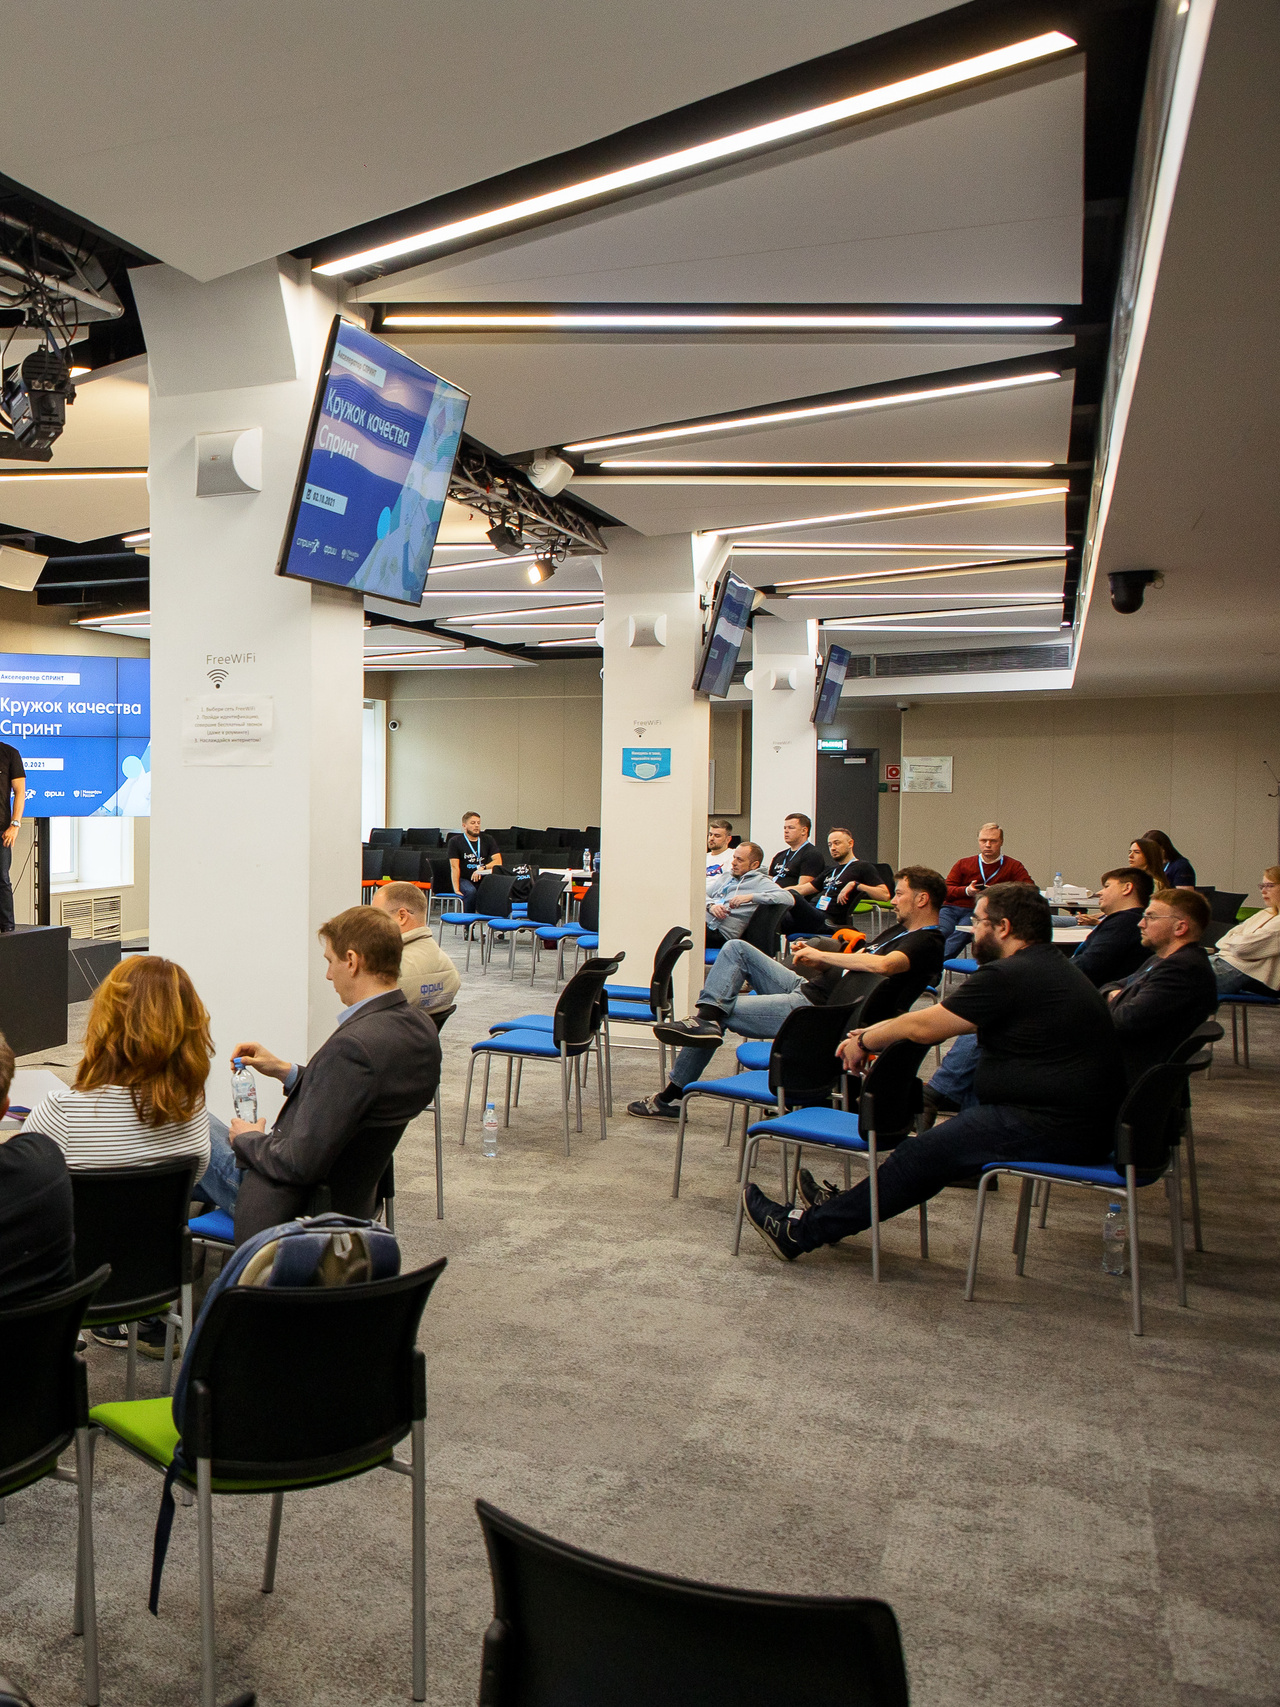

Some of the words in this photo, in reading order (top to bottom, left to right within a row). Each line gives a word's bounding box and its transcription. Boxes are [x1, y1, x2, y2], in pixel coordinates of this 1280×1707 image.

[326, 387, 366, 427] Кружок
[366, 413, 410, 447] качества
[319, 425, 359, 460] Спринт
[206, 653, 256, 665] FreeWiFi
[0, 697, 62, 716] Кружок
[68, 702, 142, 714] качества
[0, 720, 62, 740] Спринт
